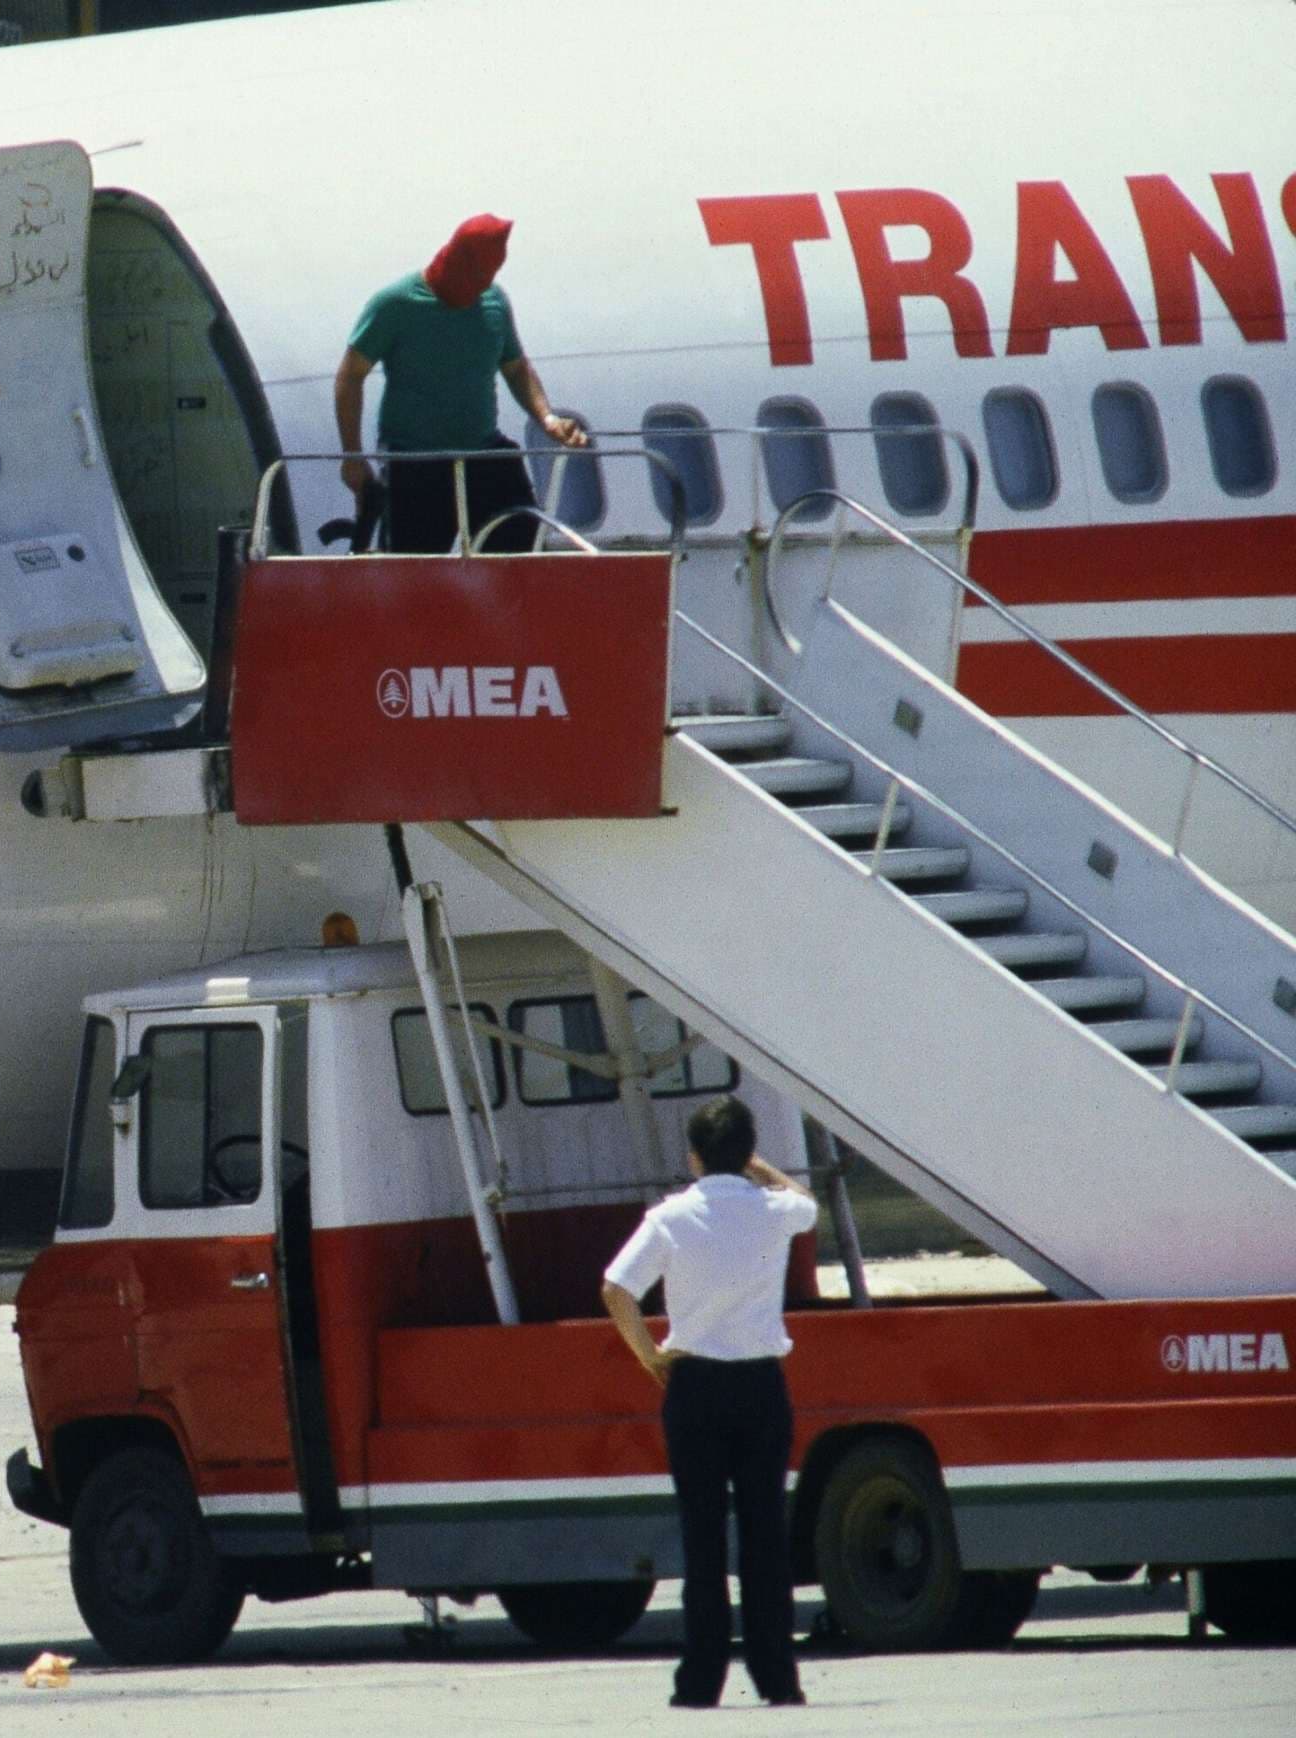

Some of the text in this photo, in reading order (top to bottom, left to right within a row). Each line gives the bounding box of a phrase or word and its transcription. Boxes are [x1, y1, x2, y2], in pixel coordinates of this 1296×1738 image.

[696, 171, 1296, 368] TRAN
[409, 665, 569, 719] MEA
[1187, 1332, 1290, 1372] MEA
